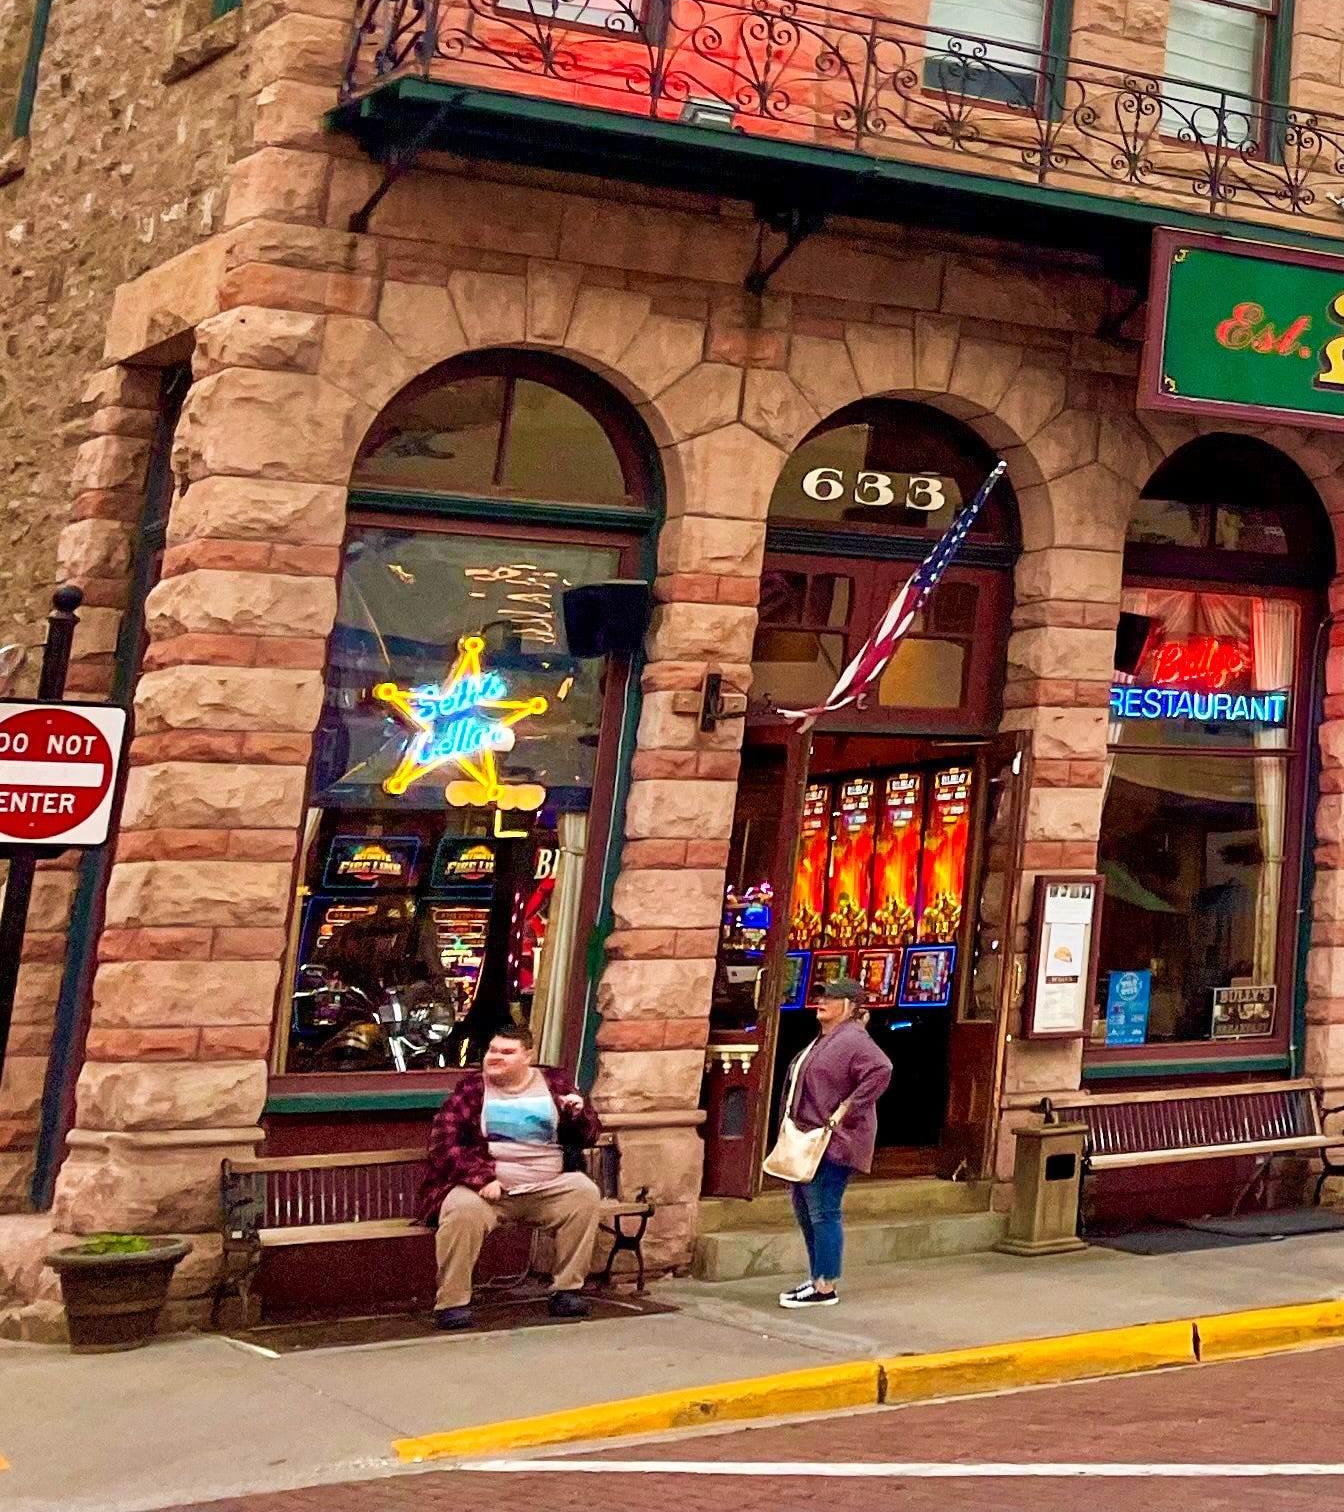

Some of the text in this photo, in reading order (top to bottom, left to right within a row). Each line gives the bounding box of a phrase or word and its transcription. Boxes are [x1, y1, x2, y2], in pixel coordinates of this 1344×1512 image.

[1215, 302, 1311, 360] Est.
[802, 467, 946, 511] 633
[1110, 688, 1287, 722] RESTAURANT
[0, 732, 98, 756] DO NOT
[0, 791, 76, 814] ENTER
